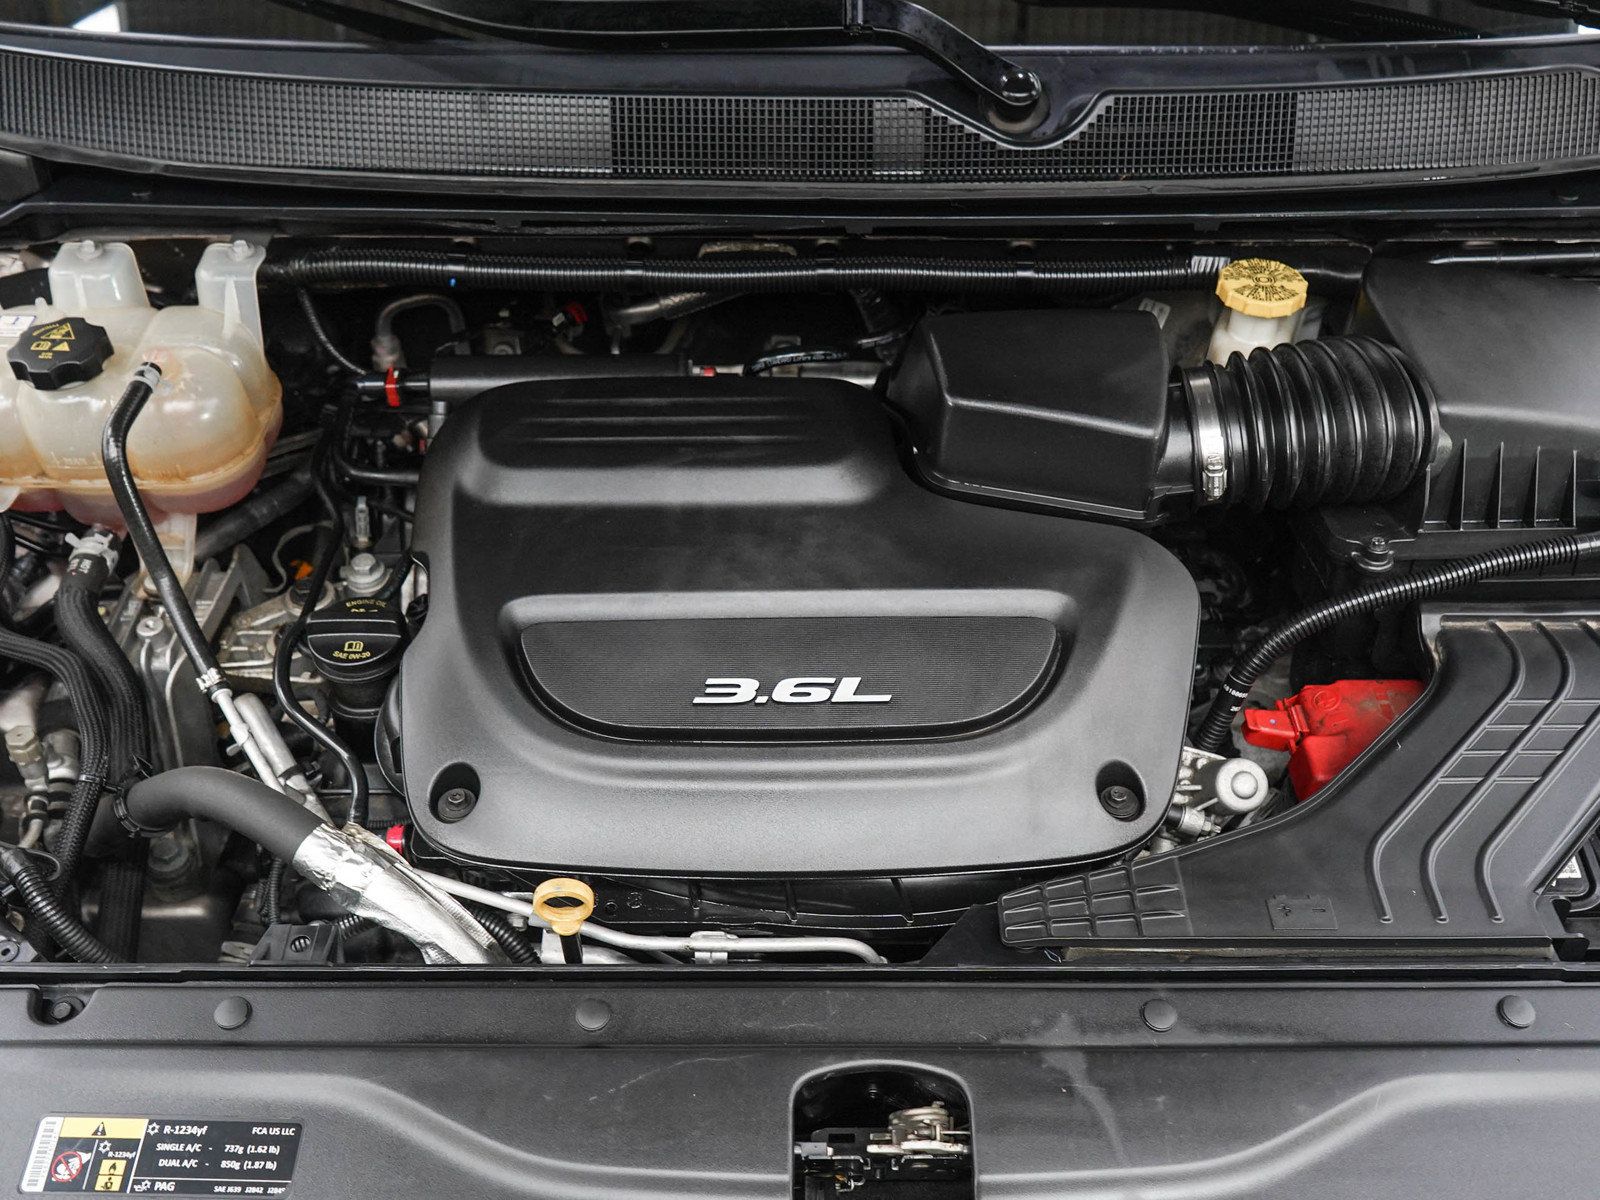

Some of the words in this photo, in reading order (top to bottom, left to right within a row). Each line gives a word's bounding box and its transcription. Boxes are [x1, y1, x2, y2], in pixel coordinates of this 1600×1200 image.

[333, 650, 348, 659] SAE
[349, 651, 371, 660] 0W-20
[692, 677, 892, 704] 3.6L
[163, 1124, 208, 1137] R-1234yf
[251, 1127, 267, 1136] FCA
[268, 1128, 280, 1136] US
[281, 1128, 296, 1136] LLC
[156, 1142, 185, 1152] SINGLE
[185, 1143, 203, 1153] A/C
[224, 1144, 244, 1155] 737g
[246, 1144, 267, 1155] (1.62
[268, 1145, 280, 1156] lb)
[107, 1150, 136, 1160] R-1234yf
[158, 1158, 181, 1167] DUAL
[181, 1159, 199, 1169] A/C
[220, 1160, 241, 1170] 850g
[243, 1160, 265, 1171] (1.87
[265, 1161, 278, 1171] lb)
[153, 1181, 176, 1192] PAG
[213, 1185, 226, 1193] SAE
